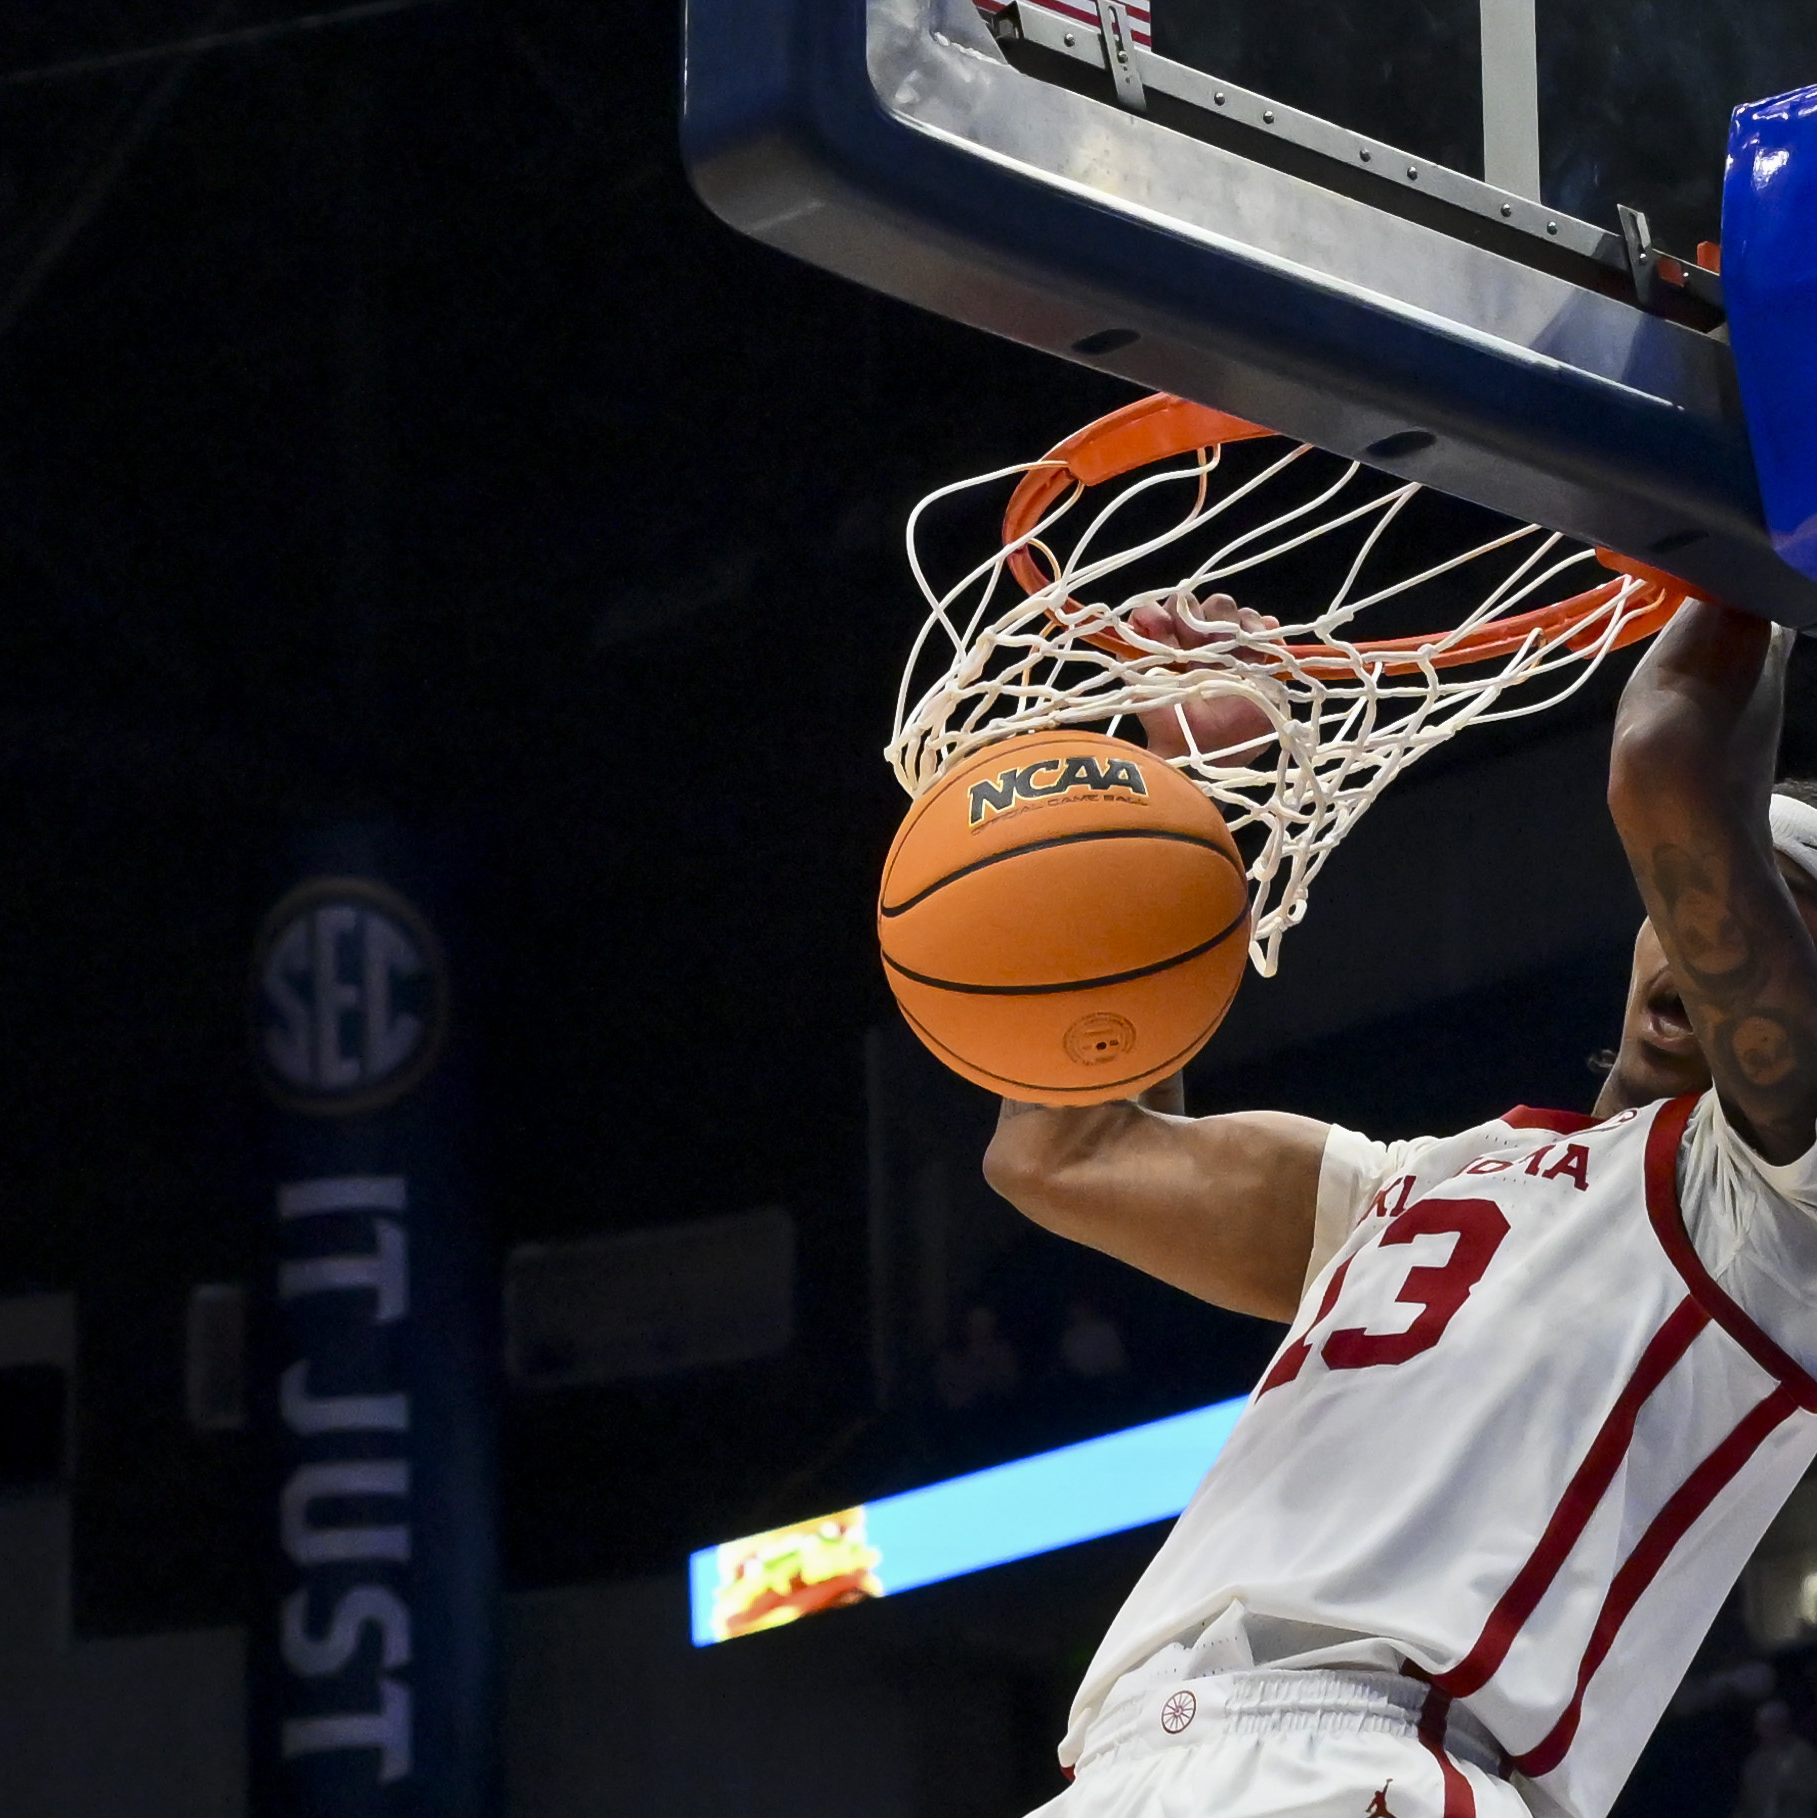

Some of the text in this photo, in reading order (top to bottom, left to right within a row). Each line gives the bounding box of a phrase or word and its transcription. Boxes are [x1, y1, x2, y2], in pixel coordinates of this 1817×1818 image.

[967, 756, 1149, 828] NCAA
[1047, 793, 1099, 807] GAME
[1103, 794, 1149, 807] BALL
[279, 1176, 408, 1326] IT
[279, 1358, 412, 1784] JUST
